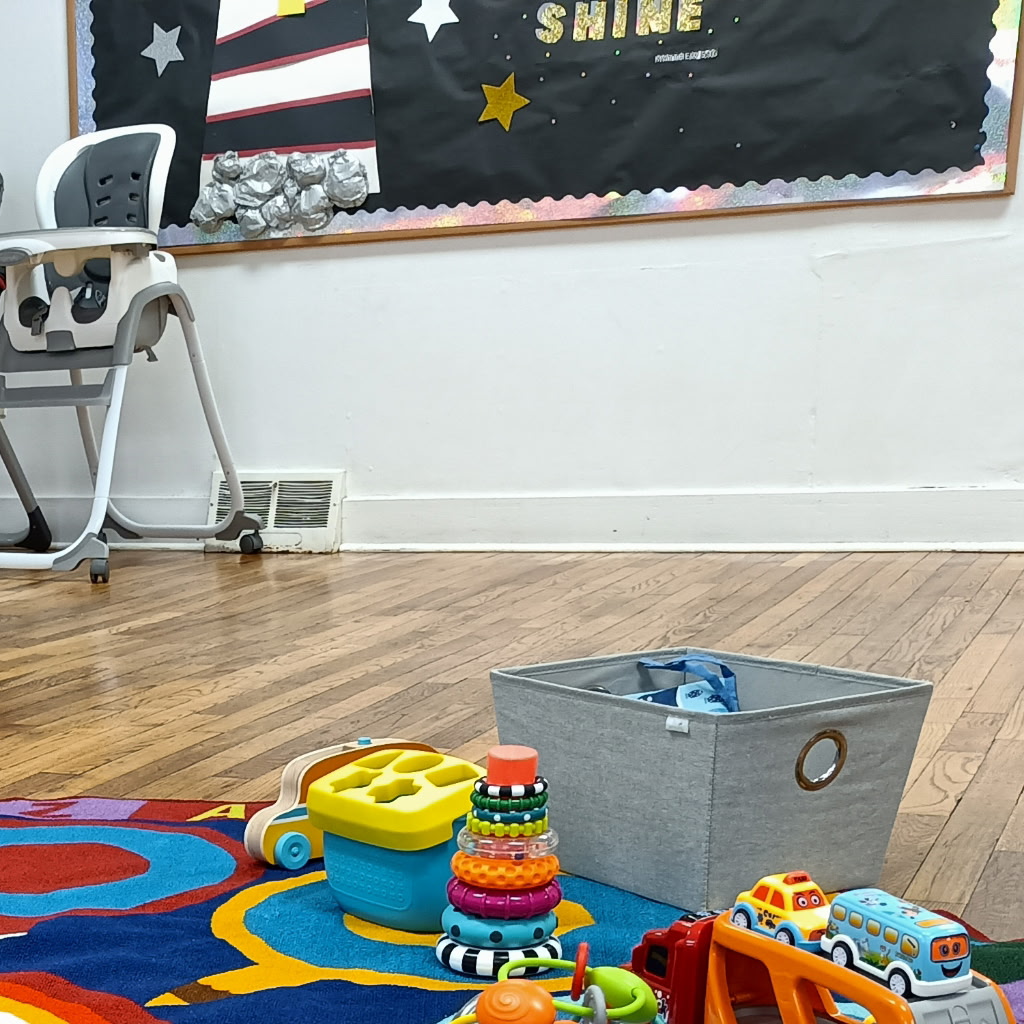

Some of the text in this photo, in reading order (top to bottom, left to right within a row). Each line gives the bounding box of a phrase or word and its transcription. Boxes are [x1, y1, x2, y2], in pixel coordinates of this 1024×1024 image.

[535, 0, 703, 44] SHINE
[18, 800, 77, 818] Z
[185, 804, 247, 822] A
